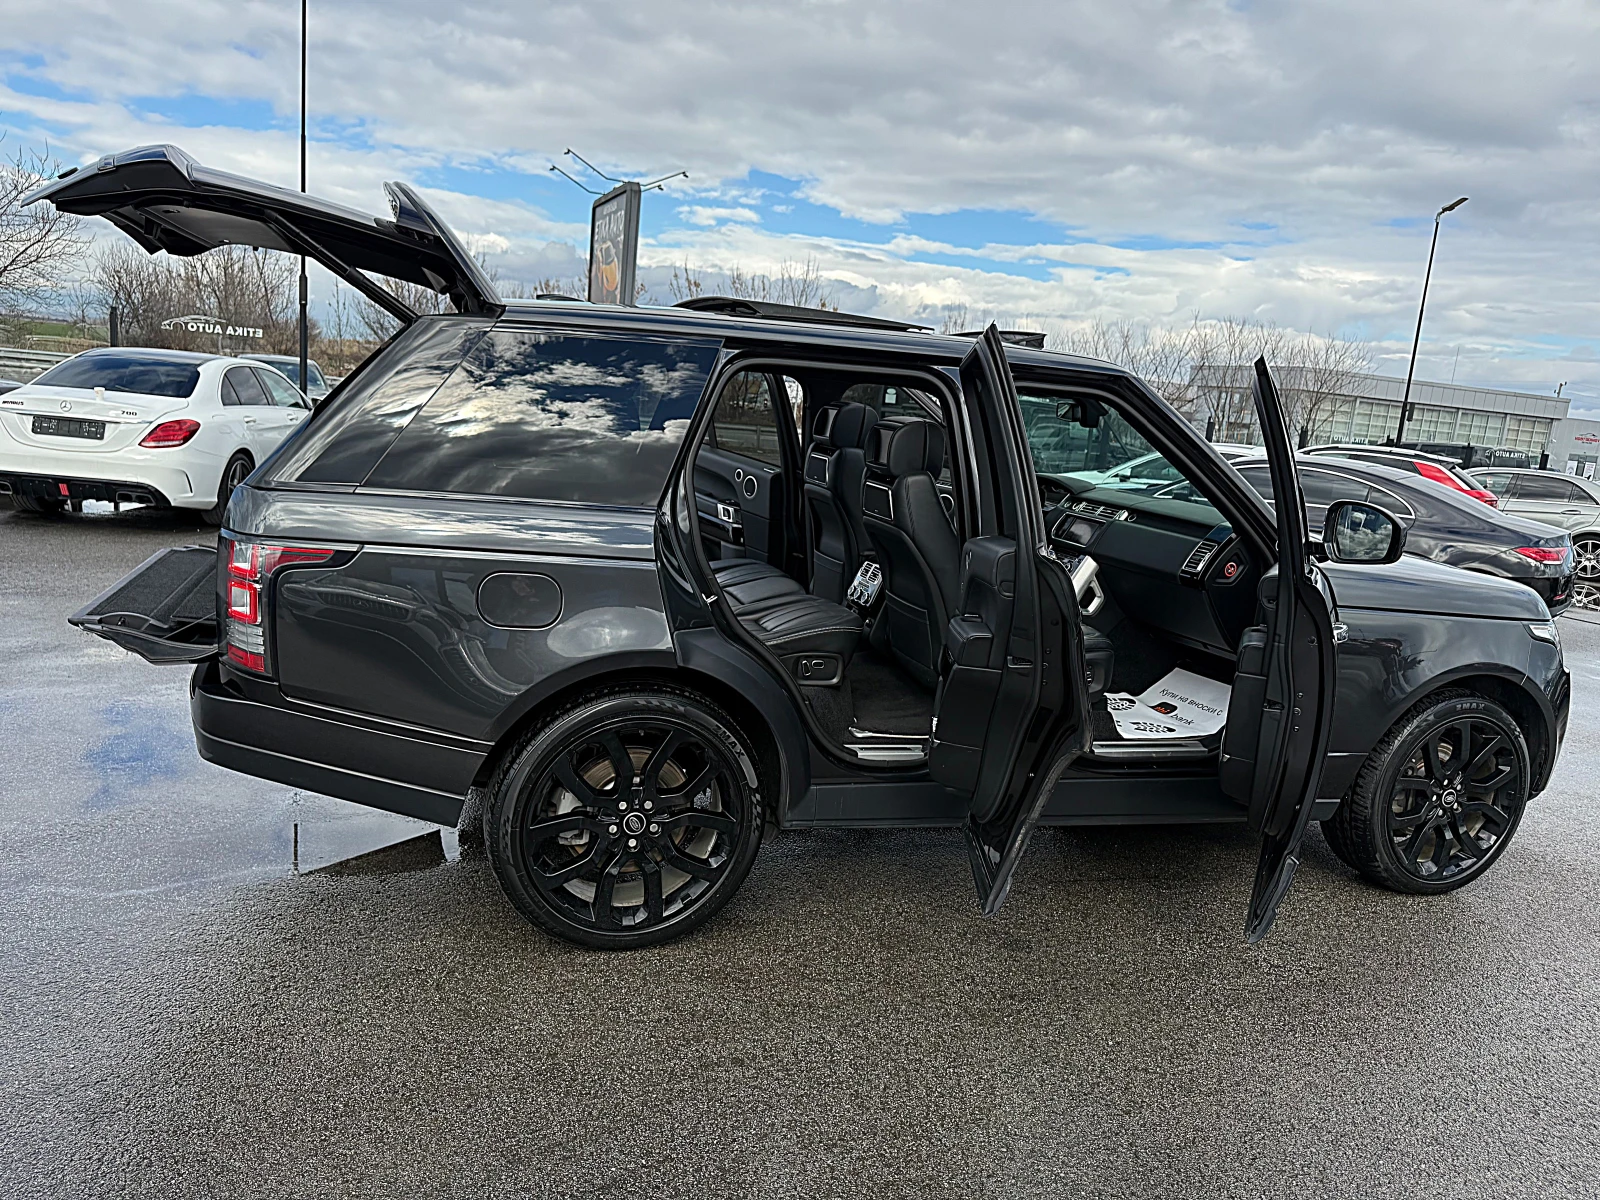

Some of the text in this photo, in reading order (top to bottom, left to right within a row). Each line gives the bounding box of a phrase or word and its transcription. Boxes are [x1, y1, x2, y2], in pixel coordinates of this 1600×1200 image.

[1159, 688, 1178, 701] Купи
[1178, 694, 1189, 703] на
[1188, 699, 1217, 716] вноски
[1170, 712, 1195, 725] bank
